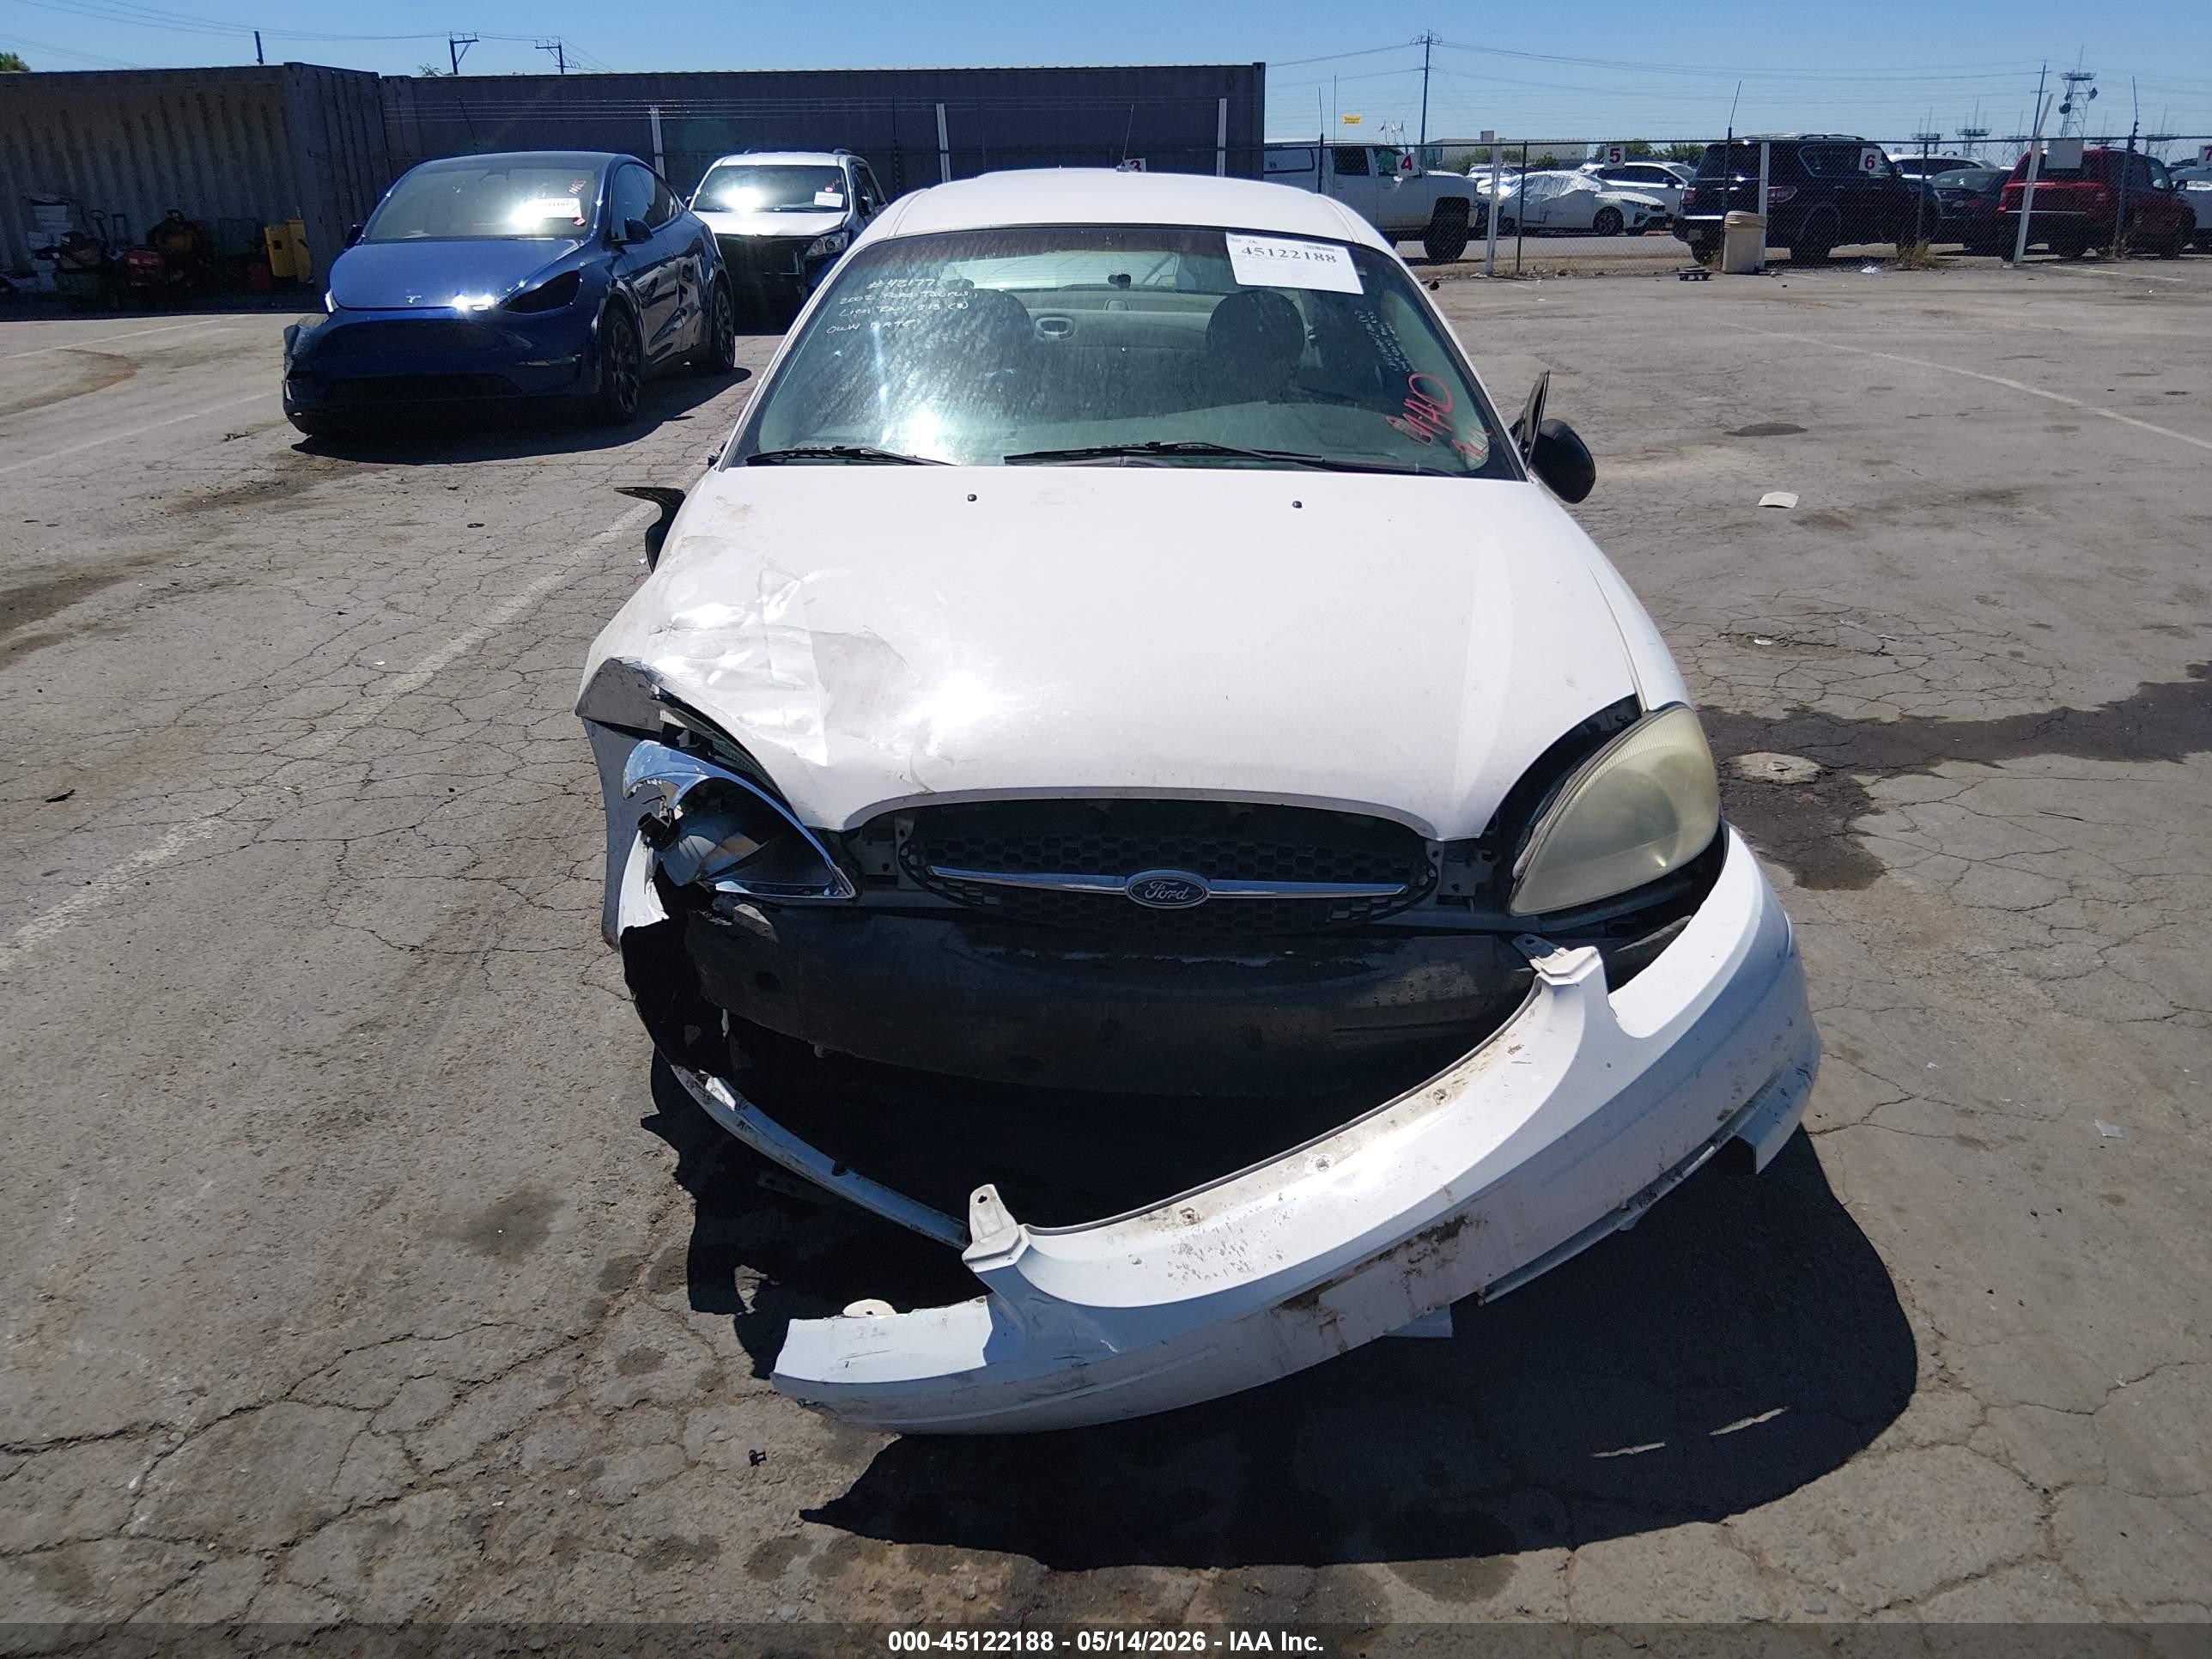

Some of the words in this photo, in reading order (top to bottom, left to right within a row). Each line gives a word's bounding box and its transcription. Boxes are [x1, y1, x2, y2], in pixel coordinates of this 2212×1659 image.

[1401, 155, 1413, 171] 4
[1609, 148, 1621, 163] 5
[1864, 155, 1875, 170] 6
[1129, 160, 1141, 172] 3
[1242, 246, 1337, 263] 45122188
[1145, 880, 1189, 900] Ford
